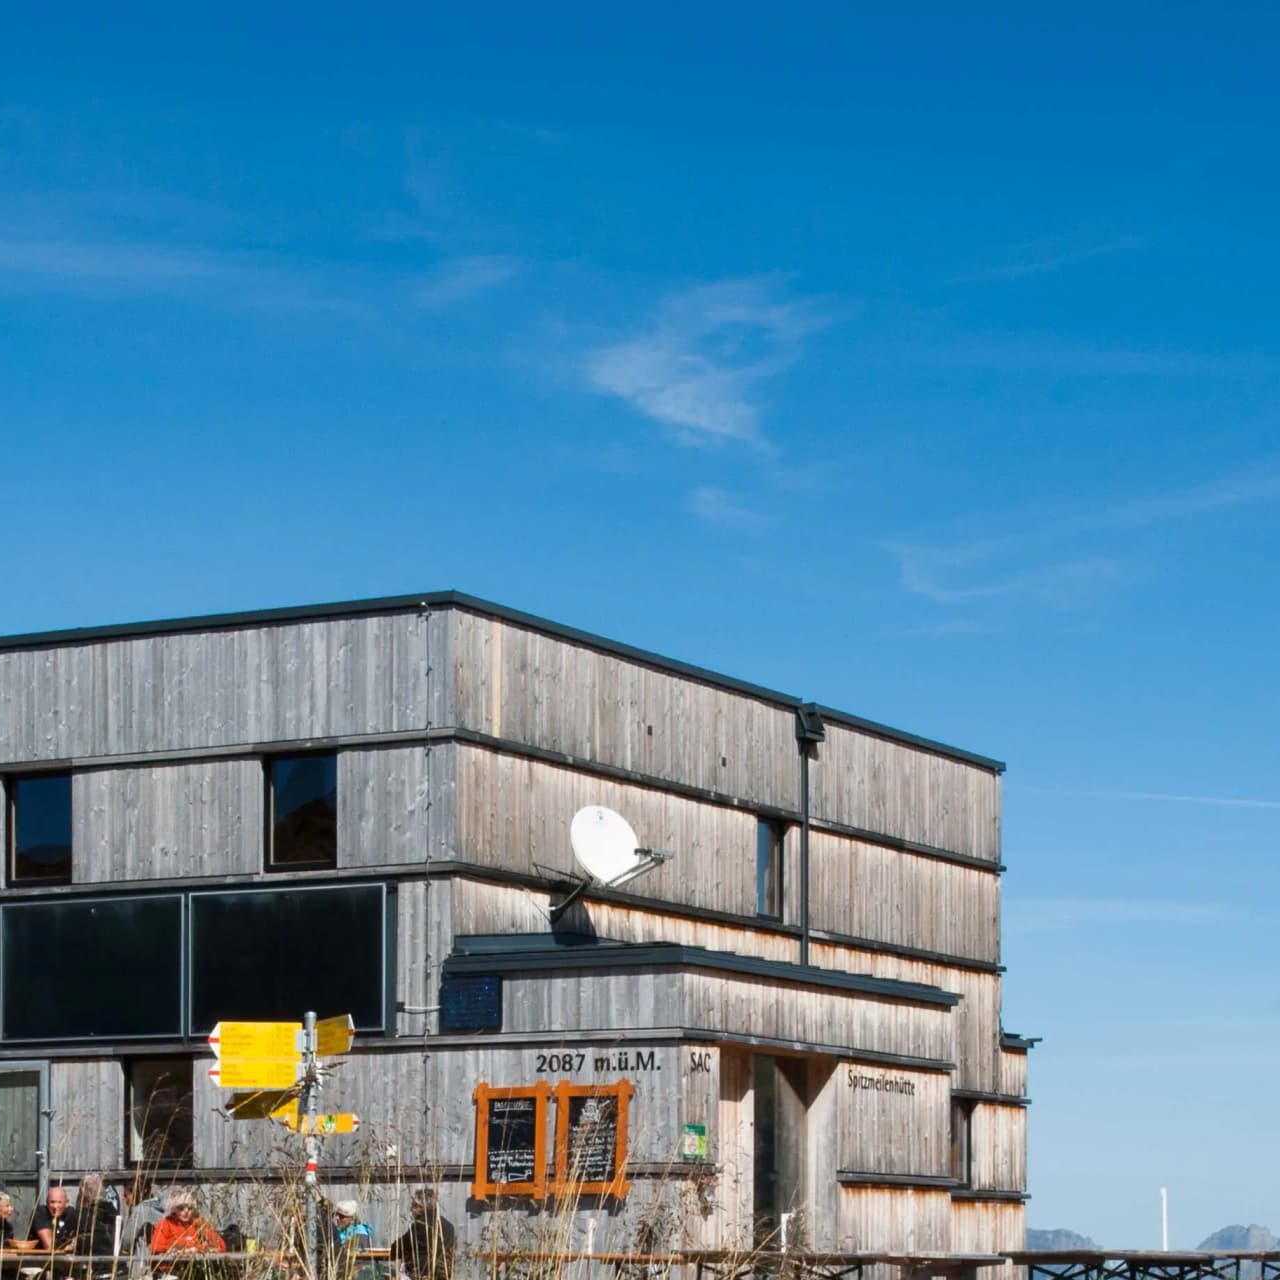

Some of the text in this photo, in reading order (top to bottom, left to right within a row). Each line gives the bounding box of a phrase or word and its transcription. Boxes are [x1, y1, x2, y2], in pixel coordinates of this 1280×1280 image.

[536, 1051, 662, 1073] 2087 m.ü.M.
[690, 1051, 712, 1073] SAC
[847, 1068, 916, 1097] Spitzmeilenhütte
